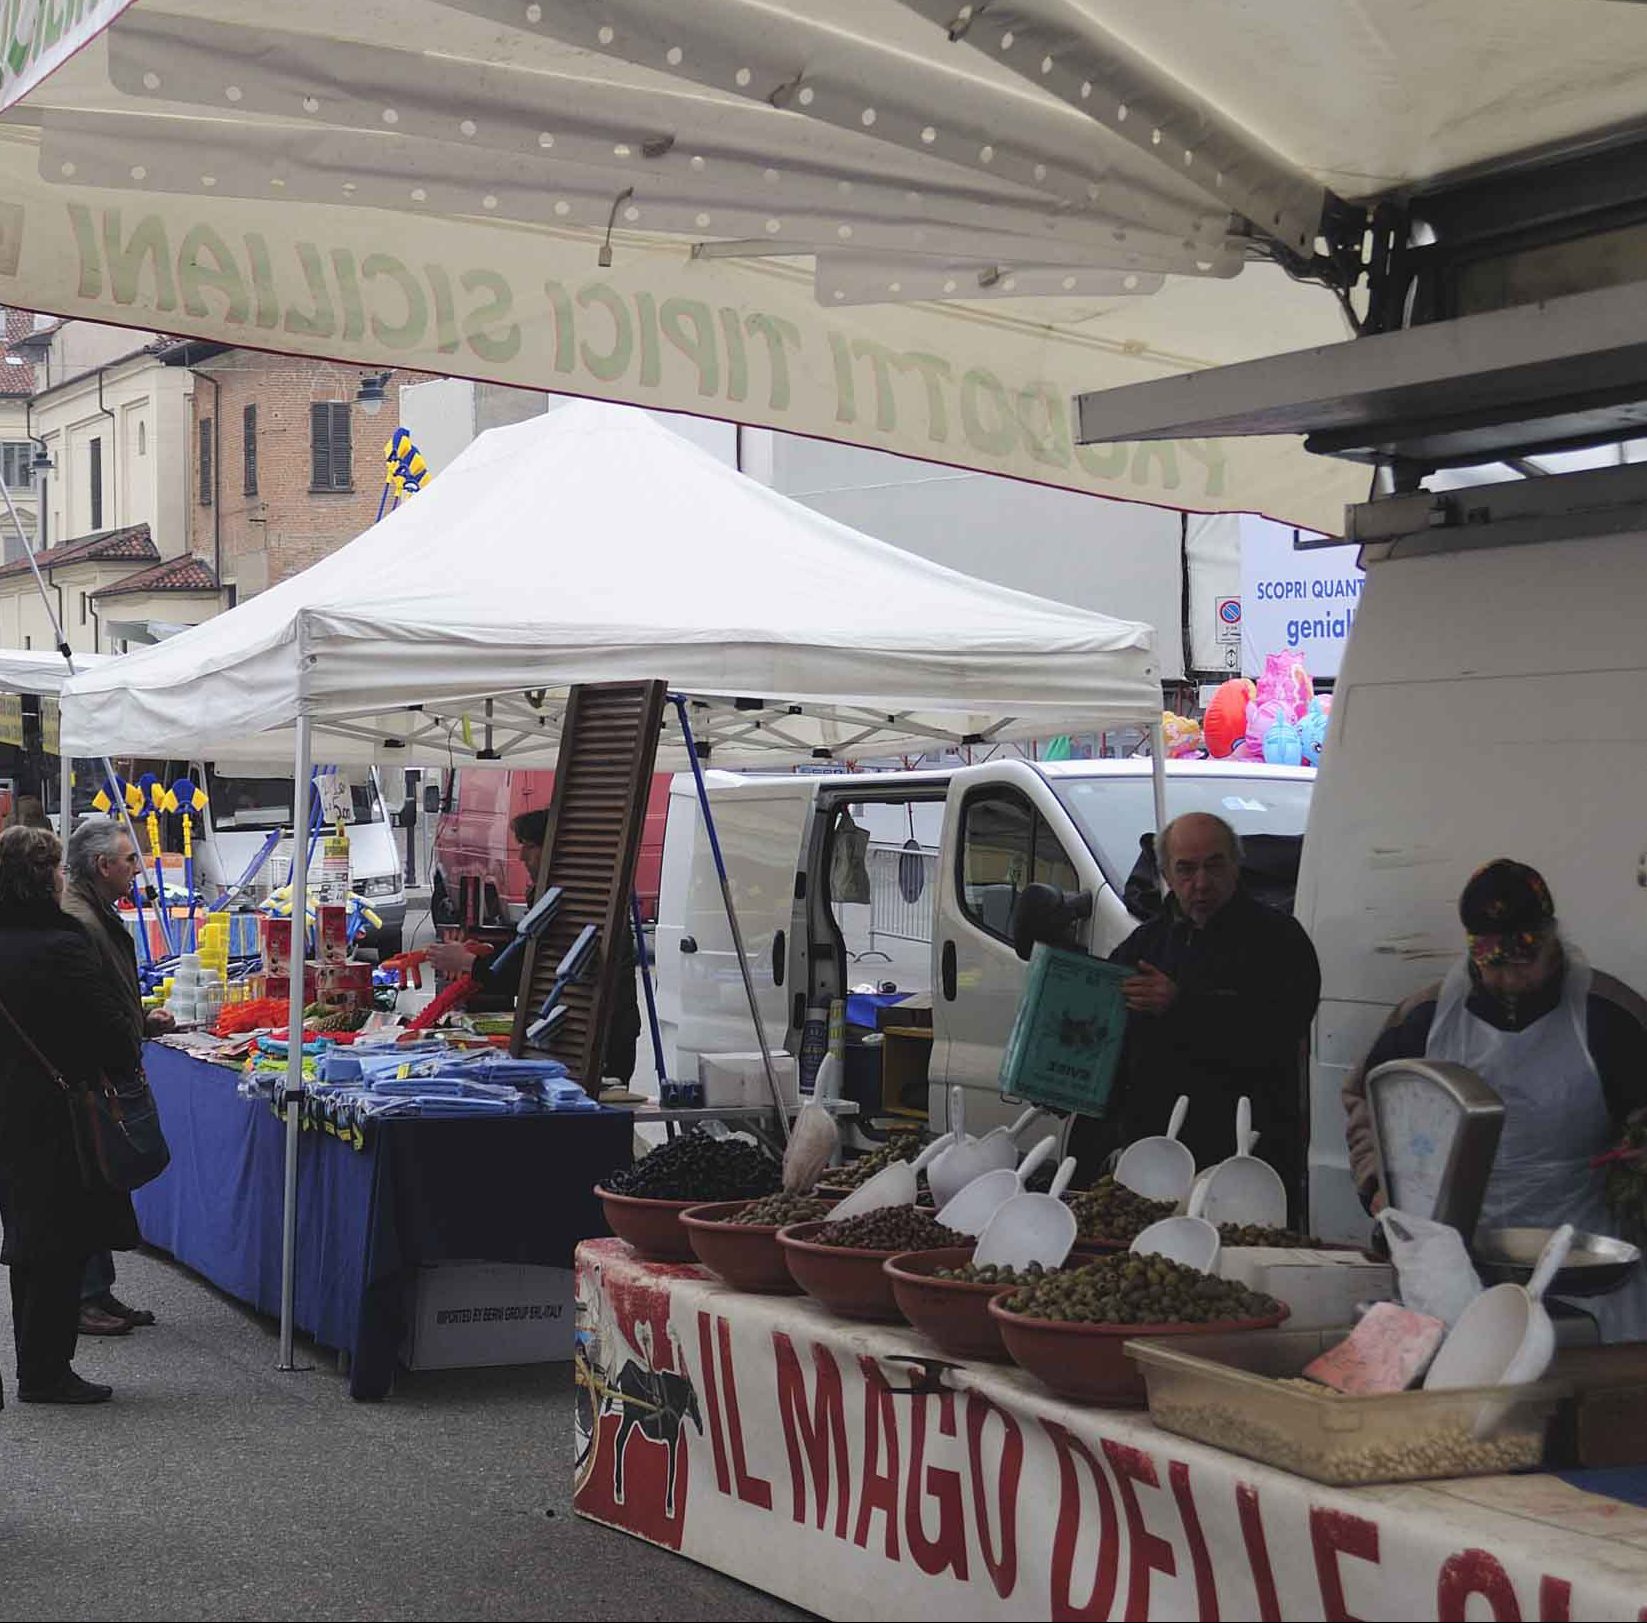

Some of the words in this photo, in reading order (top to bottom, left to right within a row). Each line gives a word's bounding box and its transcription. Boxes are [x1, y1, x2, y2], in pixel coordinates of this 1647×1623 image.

[1257, 581, 1307, 600] SCOPRI
[697, 1311, 774, 1512] IL
[772, 1330, 1025, 1600] MAGO
